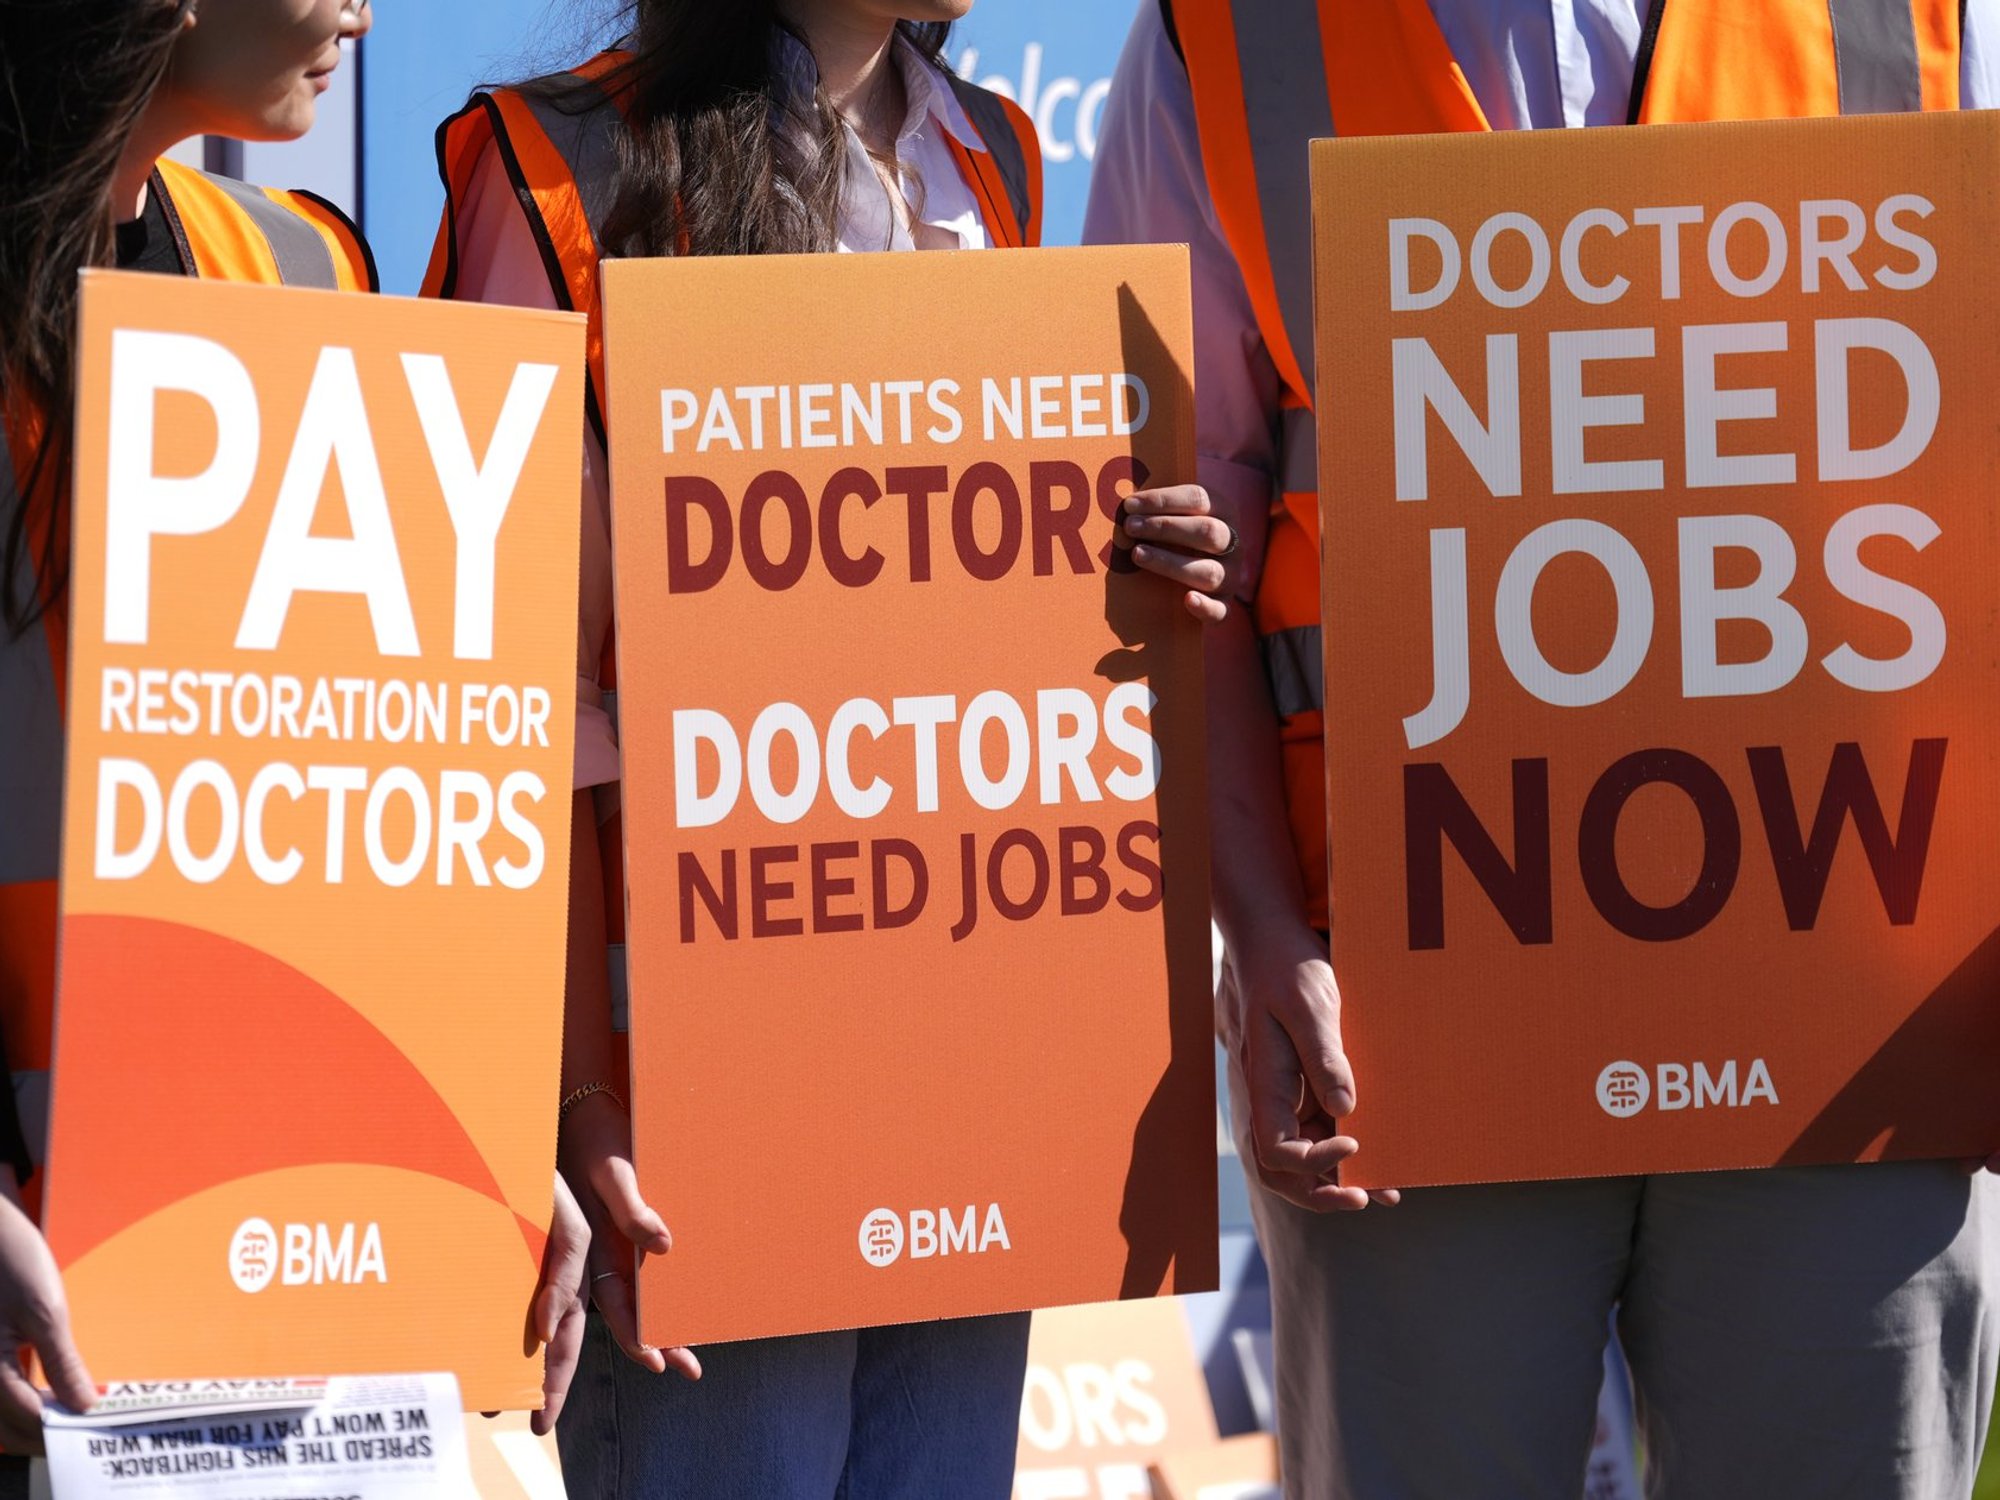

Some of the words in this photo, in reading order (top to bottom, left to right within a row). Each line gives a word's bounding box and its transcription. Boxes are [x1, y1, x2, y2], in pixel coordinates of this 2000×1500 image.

[1388, 193, 1938, 311] DOCTORS
[660, 378, 963, 453] PATIENTS
[981, 373, 1151, 443] NEED
[1391, 317, 1941, 502] NEED
[103, 328, 560, 660] PAY
[664, 456, 1151, 595] DOCTORS
[1402, 503, 1947, 750] JOBS
[99, 667, 447, 743] RESTORATION
[459, 683, 552, 748] FOR
[672, 682, 1163, 829] DOCTORS
[93, 758, 547, 889] DOCTORS
[1403, 737, 1949, 950] NOW
[677, 838, 930, 944] NEED
[950, 820, 1166, 943] JOBS
[1656, 1058, 1780, 1111] BMA
[281, 1222, 388, 1286] BMA
[909, 1202, 1012, 1259] BMA
[88, 1436, 142, 1457] WAR
[151, 1429, 203, 1451] IRAN
[210, 1424, 253, 1445] FOR
[262, 1418, 305, 1441] PAY
[314, 1412, 386, 1437] WON'T
[345, 1435, 433, 1461] SPREAD
[393, 1408, 429, 1431] WE
[102, 1450, 235, 1479] FIGHTBACK:
[242, 1445, 288, 1468] NHS
[298, 1441, 338, 1464] THE
